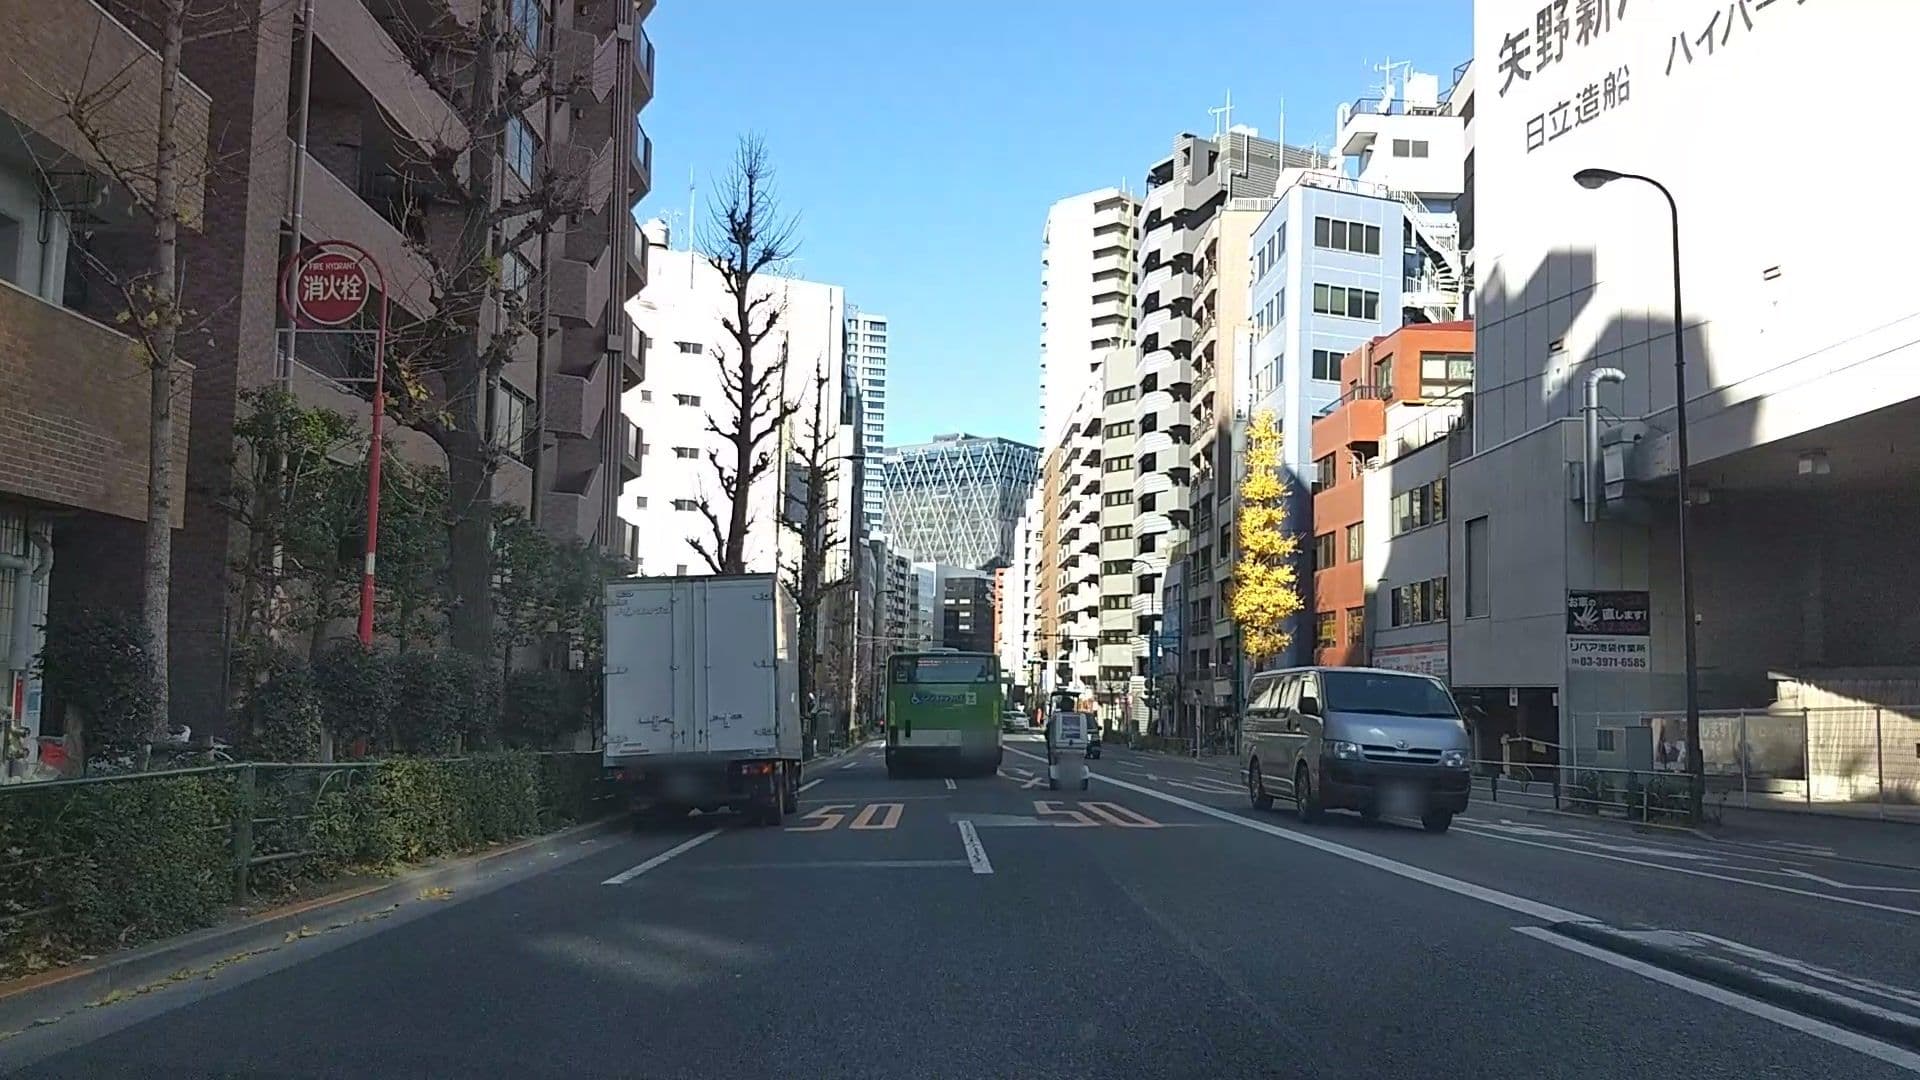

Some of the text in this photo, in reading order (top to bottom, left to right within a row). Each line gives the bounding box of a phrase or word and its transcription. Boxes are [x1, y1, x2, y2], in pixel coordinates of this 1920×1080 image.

[1498, 0, 1626, 97] 矢野新
[1526, 64, 1631, 154] 日立造船
[309, 262, 324, 270] FIRE
[303, 274, 362, 301] 消火栓
[1581, 657, 1646, 668] 03-3971-6585
[784, 803, 904, 831] 50
[1034, 801, 1164, 828] 50
